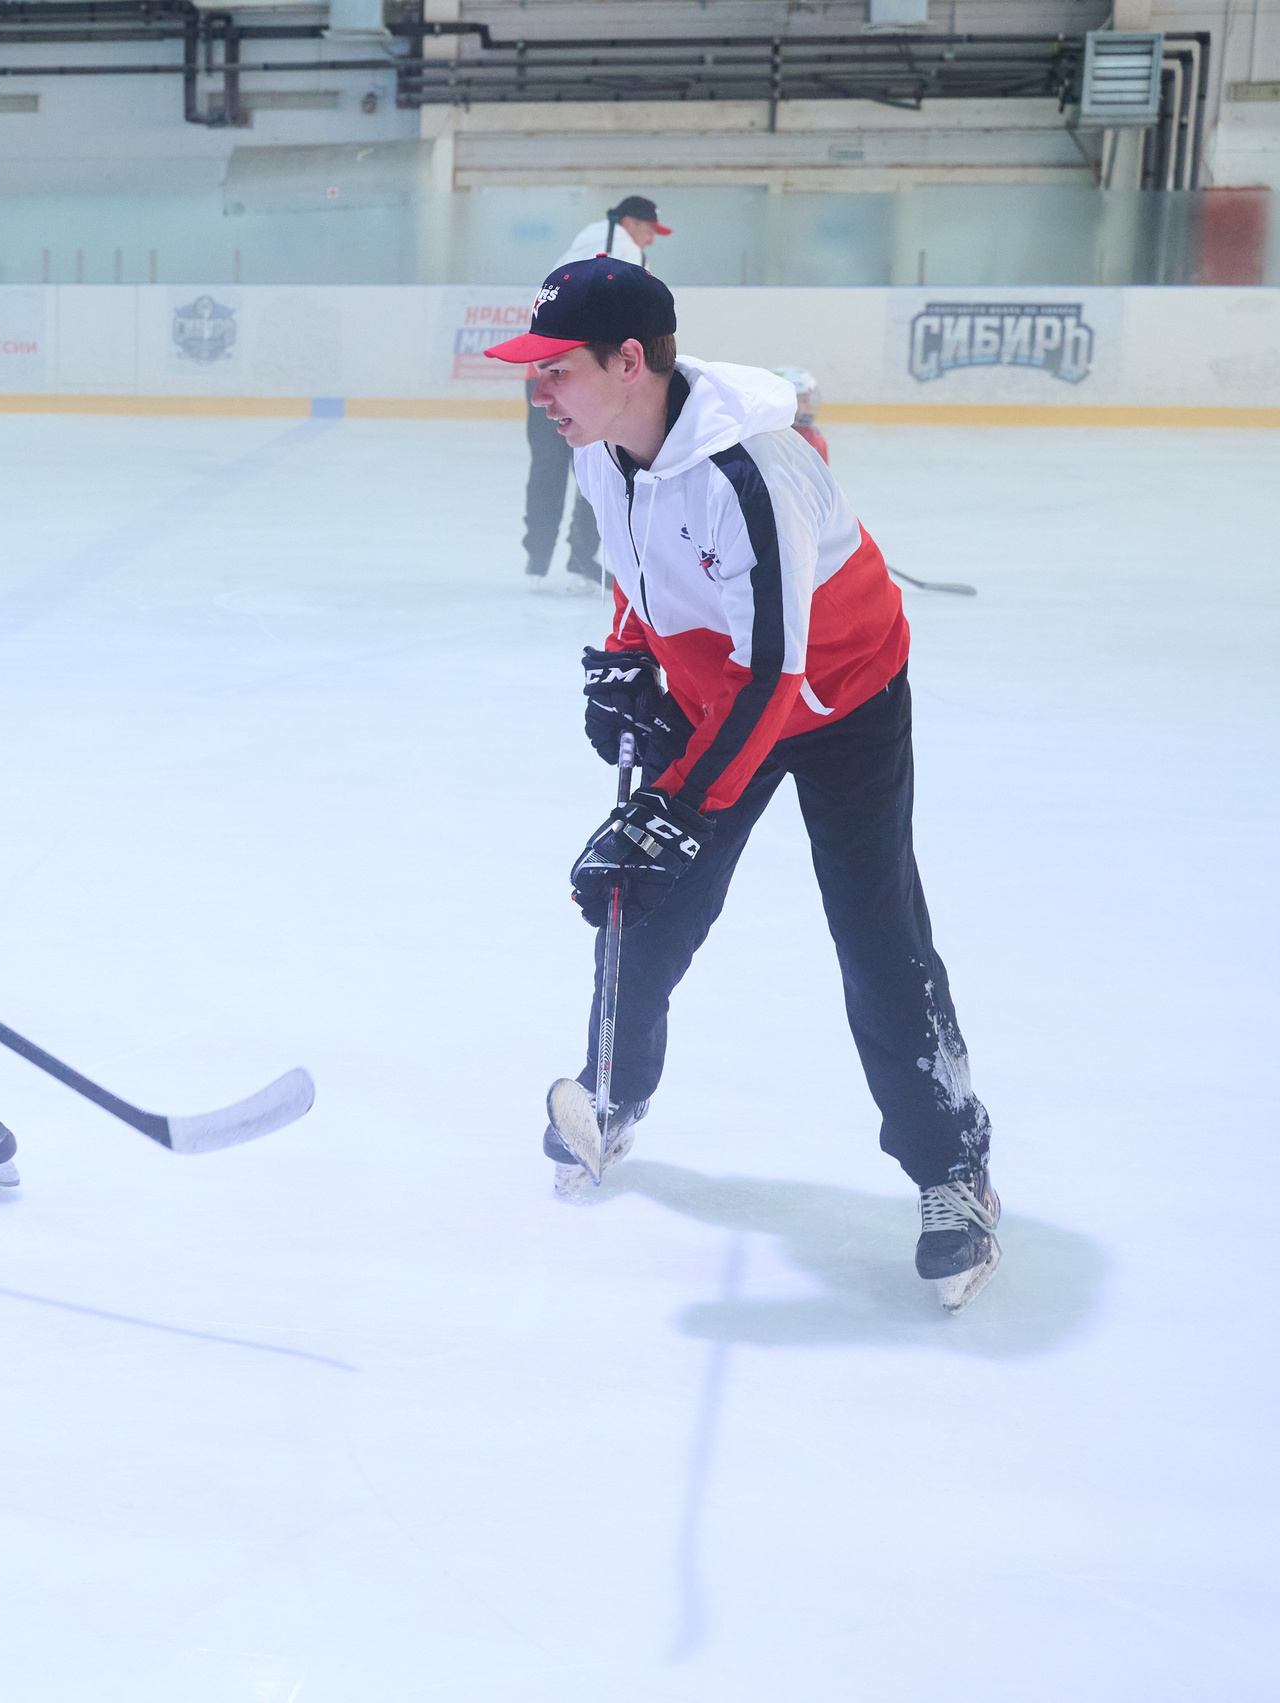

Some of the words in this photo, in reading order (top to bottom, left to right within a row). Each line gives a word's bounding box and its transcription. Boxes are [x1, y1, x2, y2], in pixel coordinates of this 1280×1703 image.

[464, 306, 532, 325] КРАСН
[909, 314, 1093, 384] СИБИРЬ
[585, 667, 641, 686] CM
[645, 814, 701, 860] CC
